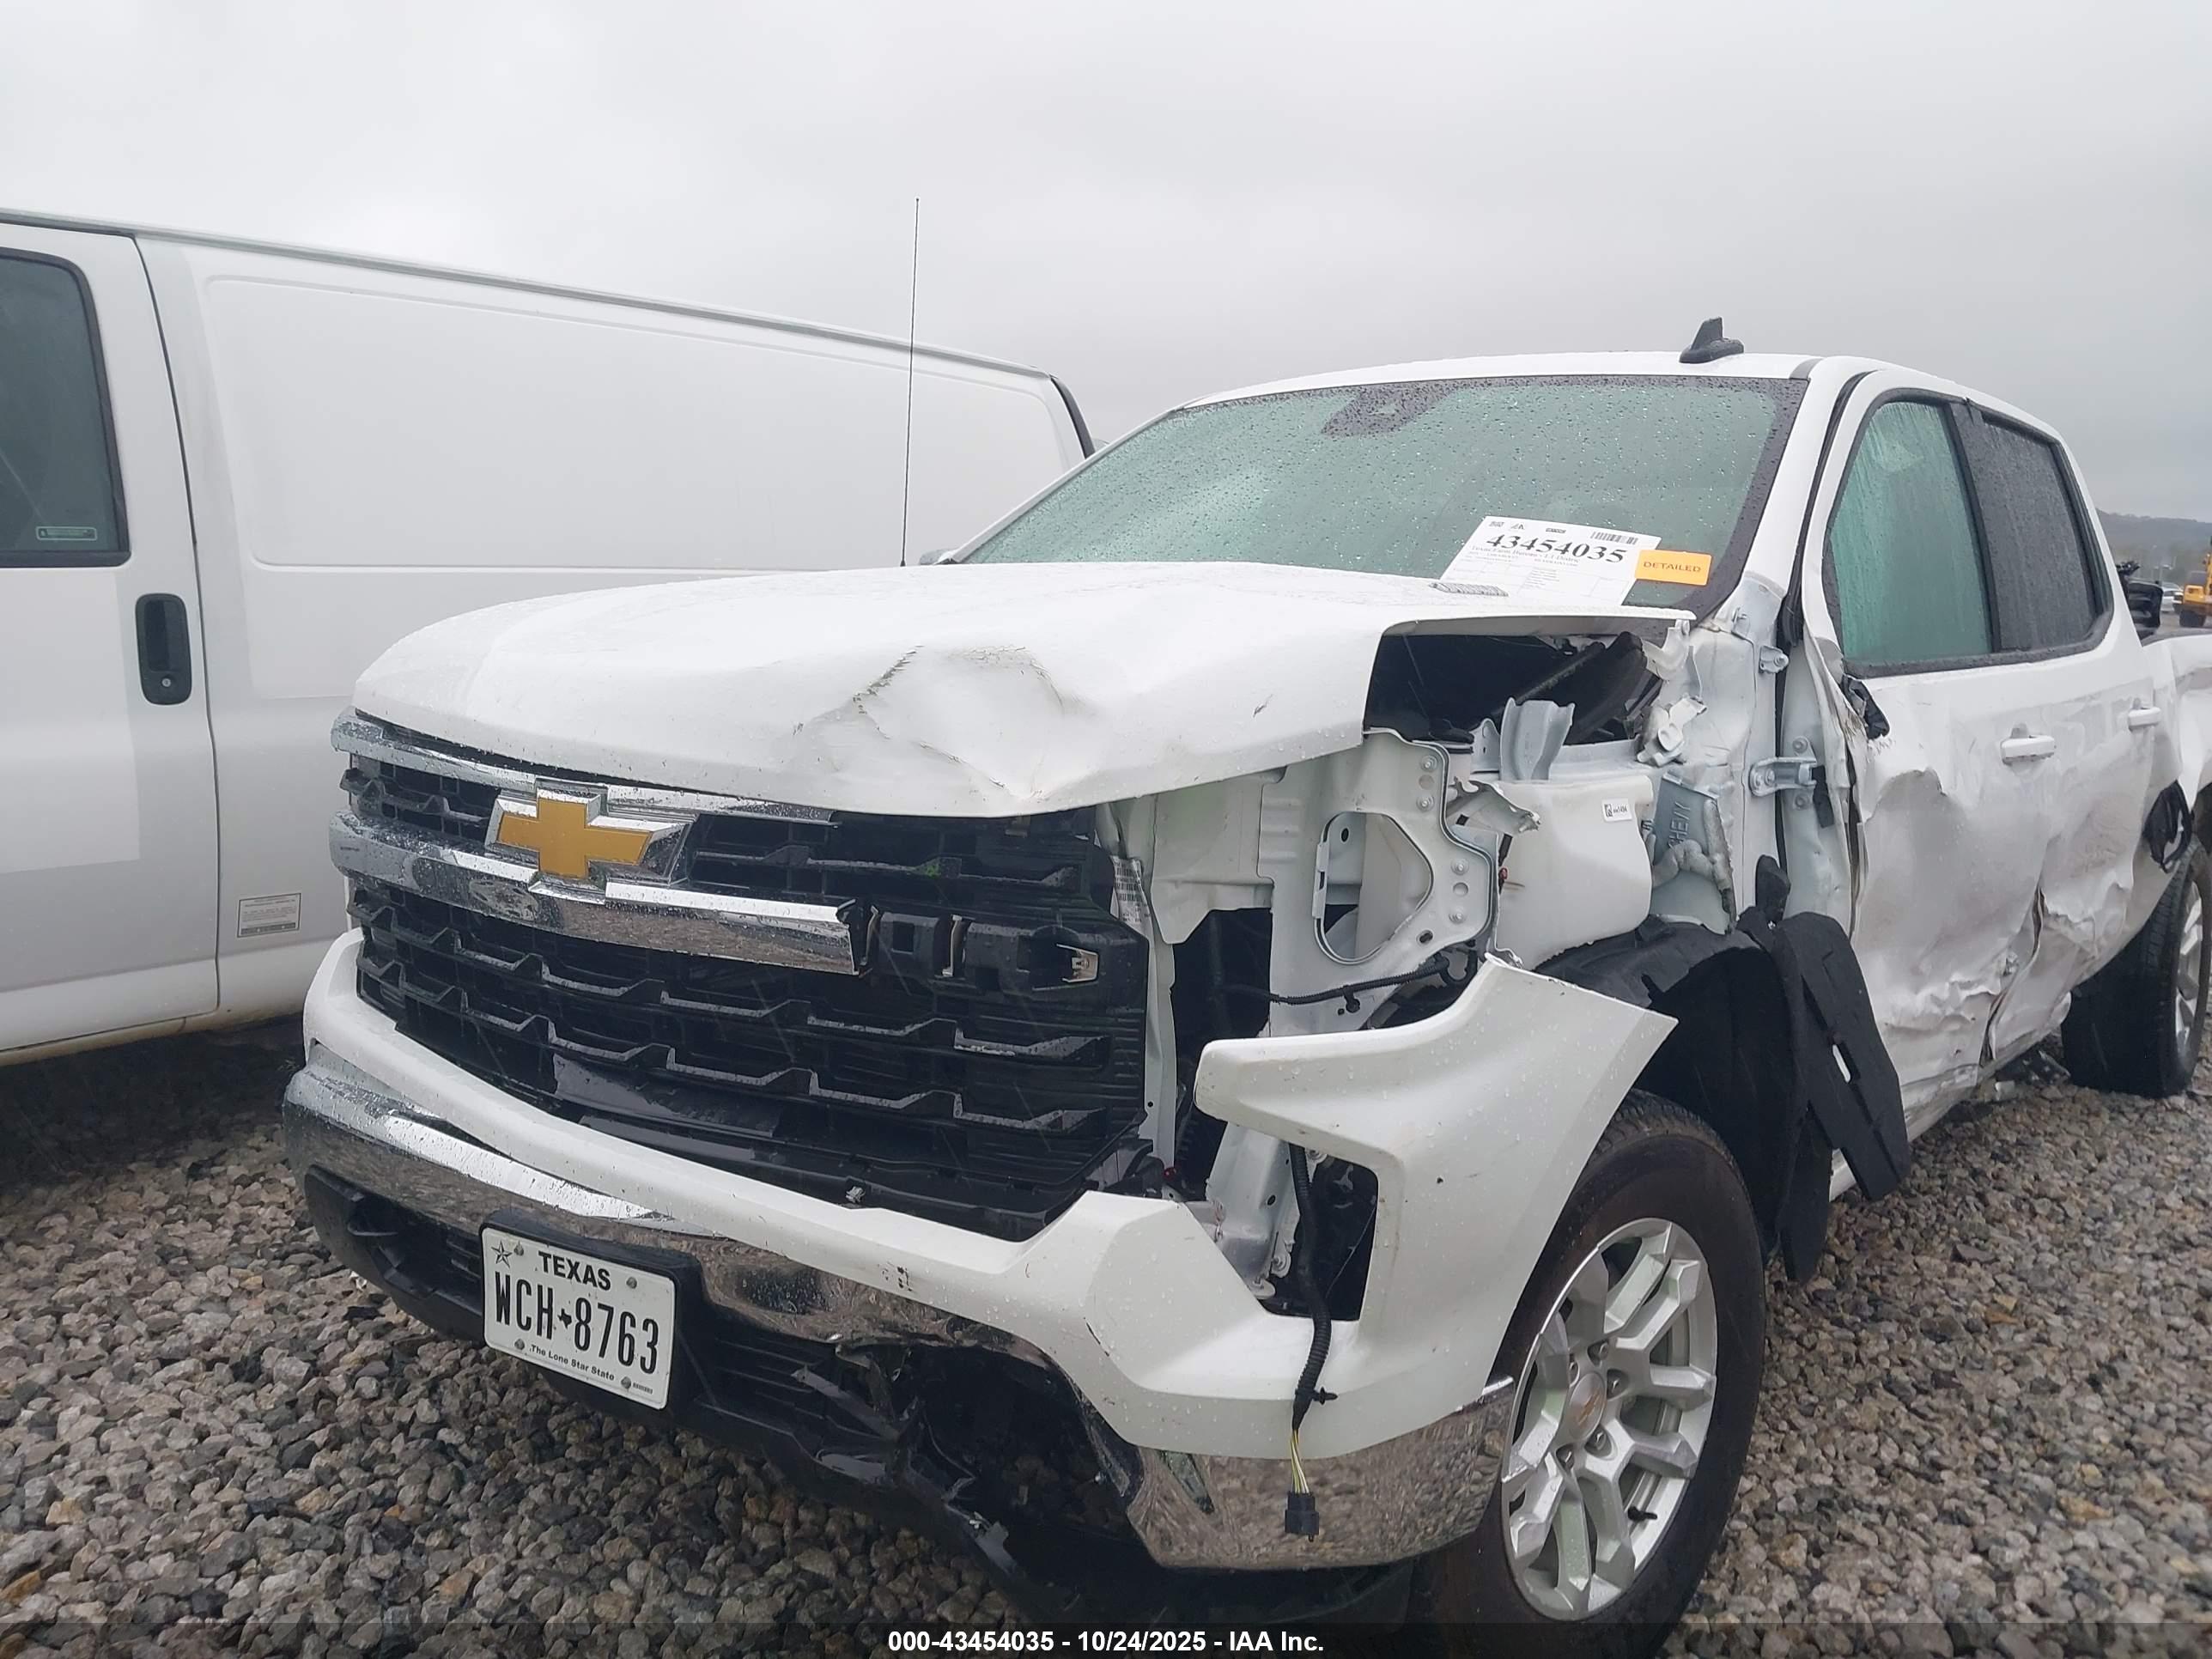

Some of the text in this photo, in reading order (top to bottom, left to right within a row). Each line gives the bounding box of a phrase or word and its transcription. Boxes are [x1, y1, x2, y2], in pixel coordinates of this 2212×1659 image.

[1486, 534, 1629, 564] 43454035
[1643, 561, 1701, 574] DETAILED
[538, 1251, 611, 1291] TEXAS
[530, 1344, 615, 1381] The Lone Star State
